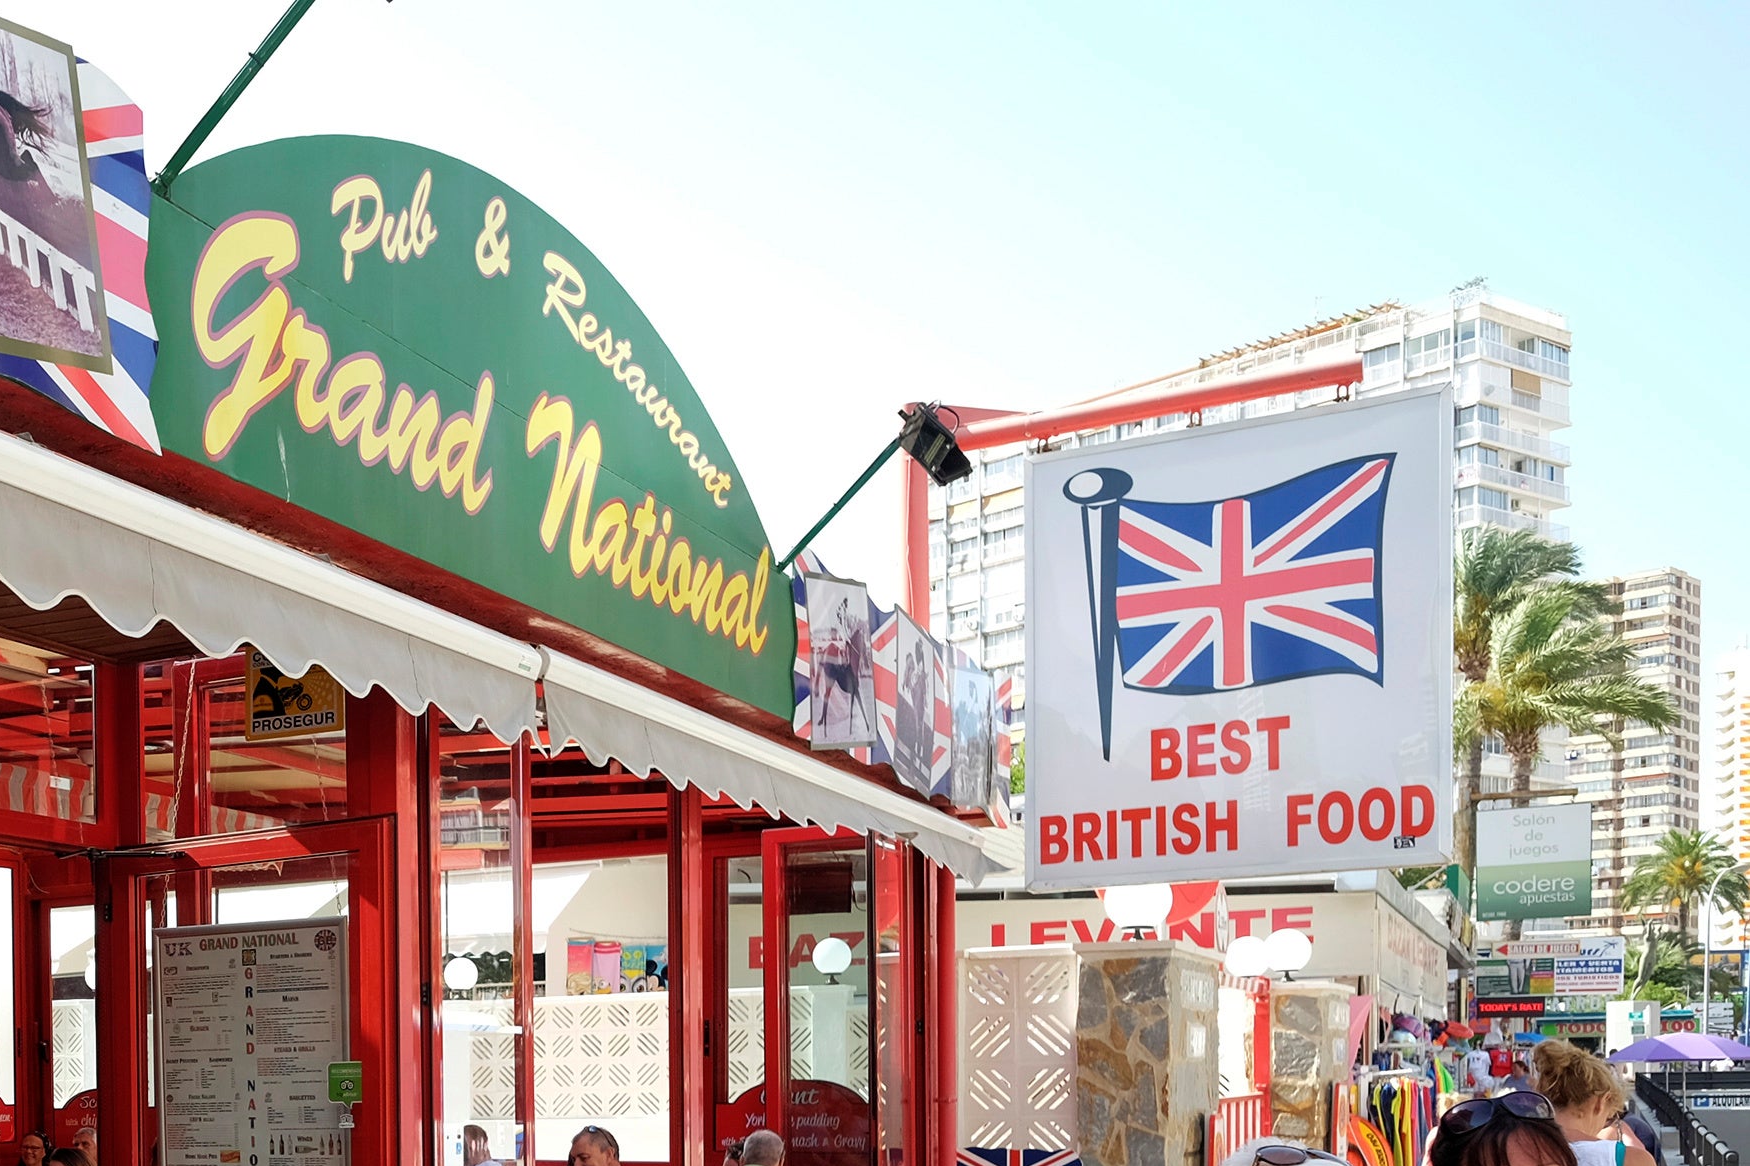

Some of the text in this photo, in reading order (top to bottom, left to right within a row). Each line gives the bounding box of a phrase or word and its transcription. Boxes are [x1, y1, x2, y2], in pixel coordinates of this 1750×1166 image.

[331, 169, 733, 508] Pub & Restaurant
[191, 210, 769, 657] Grand National
[252, 712, 335, 733] PROSEGUR
[1150, 715, 1291, 781] BEST
[1039, 784, 1435, 866] BRITISH FOOD
[1524, 829, 1543, 842] de
[1509, 843, 1559, 858] juegos
[1493, 874, 1575, 896] codere
[1519, 890, 1576, 906] apuestas
[991, 906, 1314, 948] LEVNTE
[164, 941, 193, 957] UK
[199, 937, 238, 951] GRAND
[241, 932, 300, 949] NATIONAL
[1479, 1002, 1517, 1013] TODAY'S
[1520, 1002, 1543, 1012] RATE
[797, 1113, 840, 1129] pudding
[834, 1134, 866, 1150] Gravy
